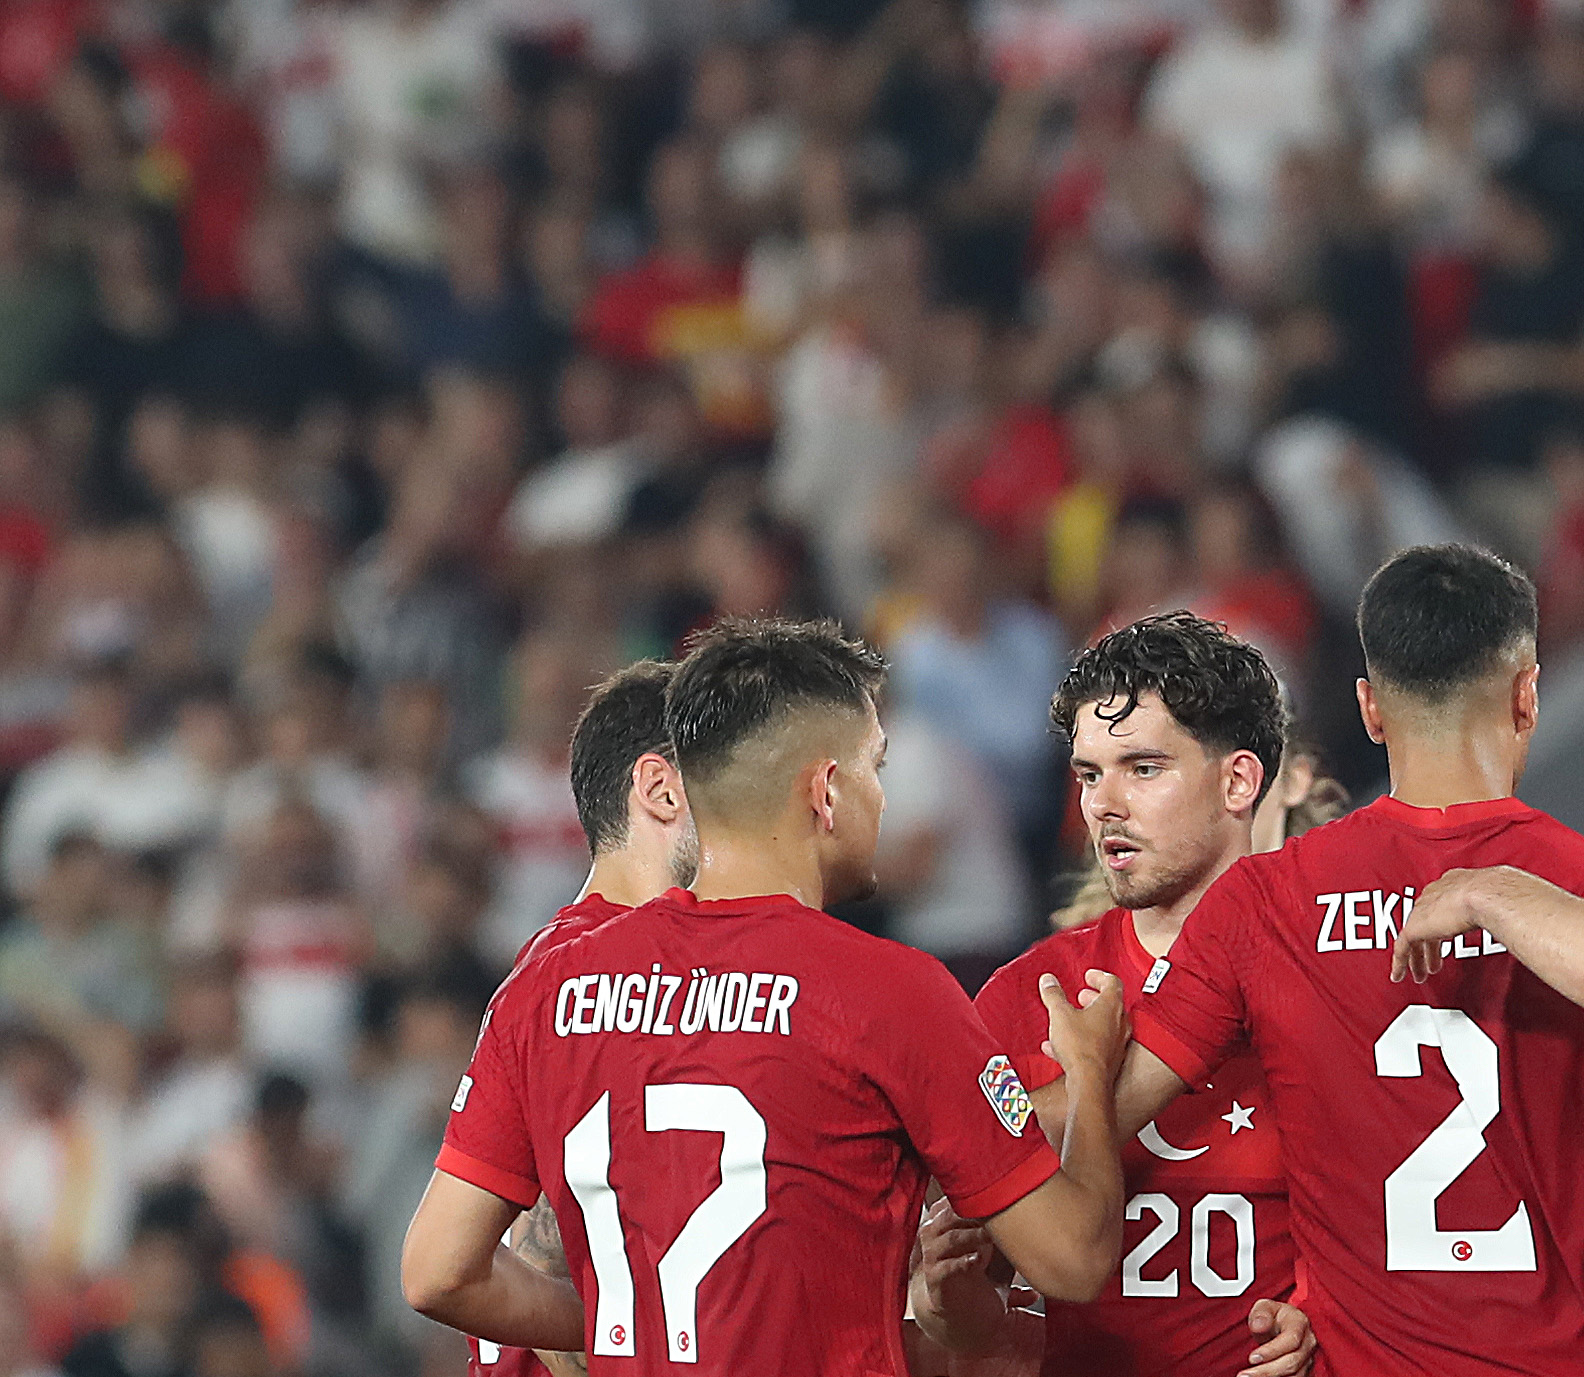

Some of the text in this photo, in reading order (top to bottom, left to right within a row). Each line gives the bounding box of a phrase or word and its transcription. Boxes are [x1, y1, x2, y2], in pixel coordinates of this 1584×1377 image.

[1316, 886, 1415, 953] ZEKİ
[554, 962, 799, 1038] CENGİZ ÜNDER
[1374, 1004, 1537, 1271] 2
[563, 1082, 768, 1364] 17
[1121, 1192, 1256, 1298] 20
